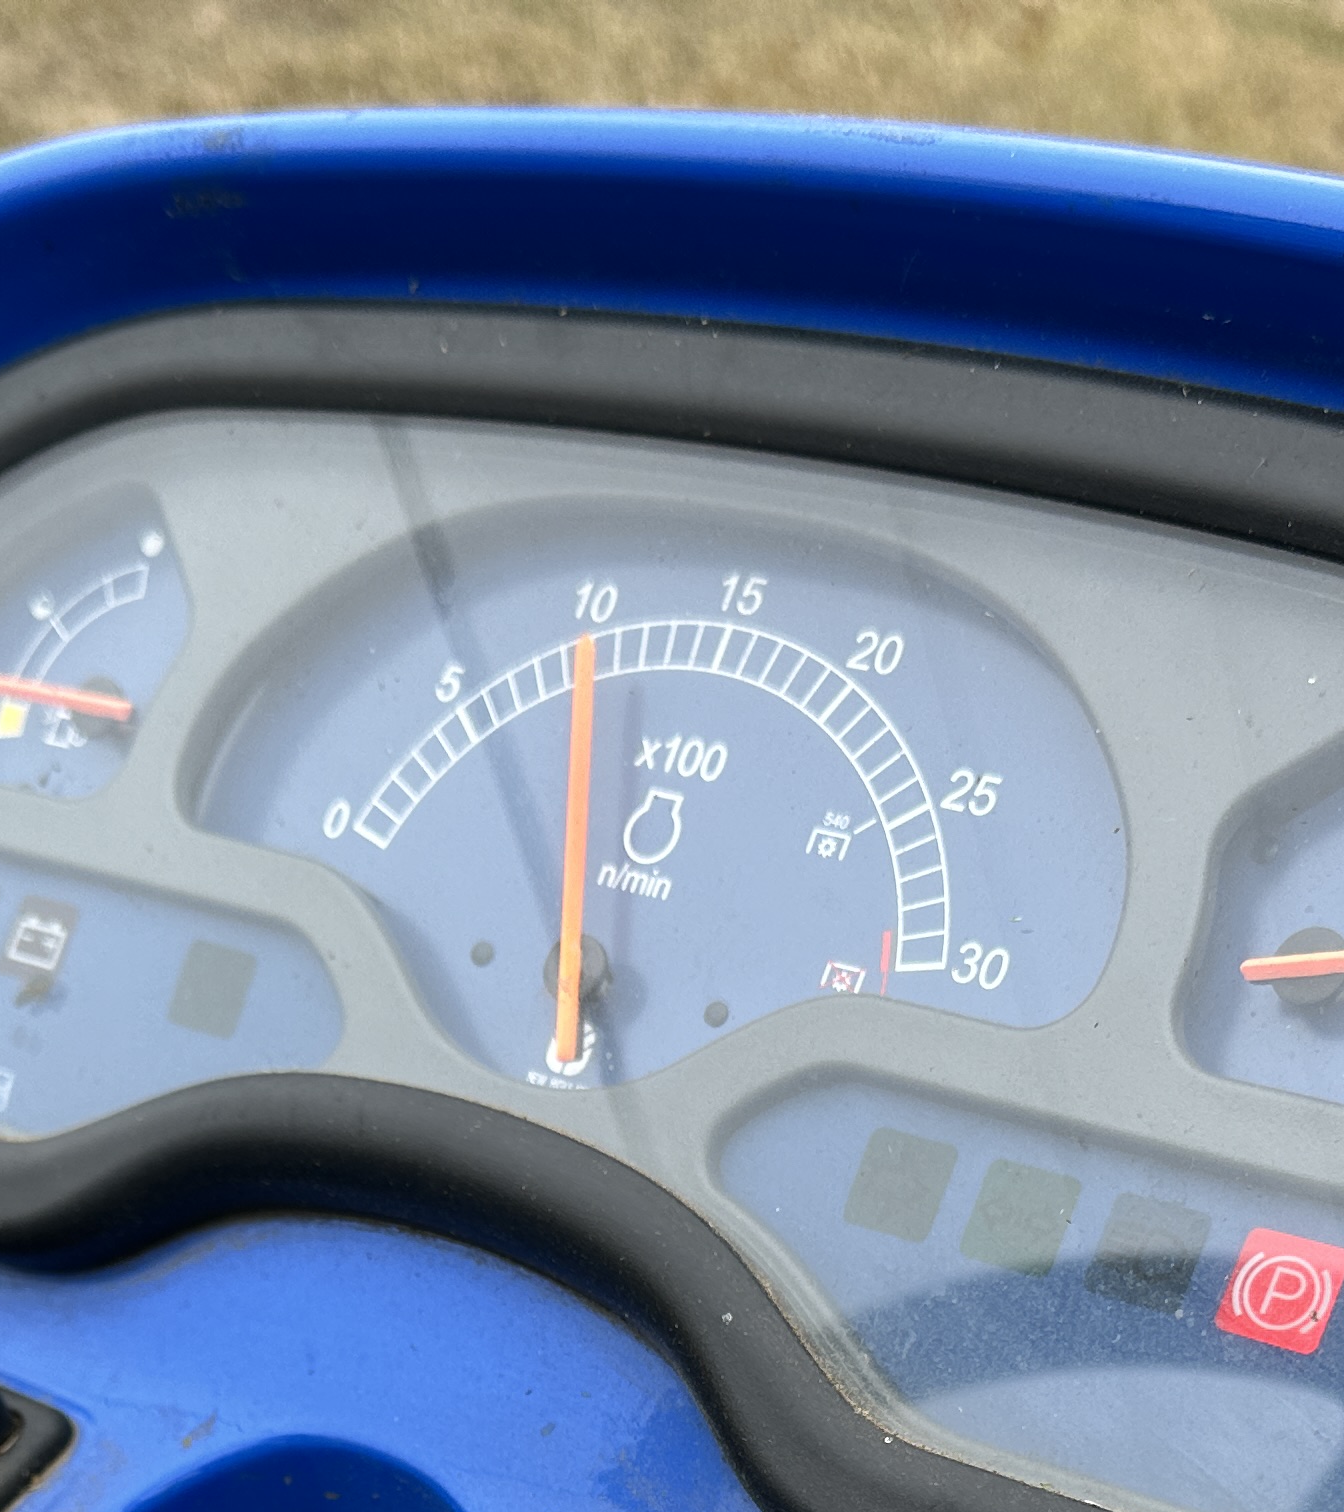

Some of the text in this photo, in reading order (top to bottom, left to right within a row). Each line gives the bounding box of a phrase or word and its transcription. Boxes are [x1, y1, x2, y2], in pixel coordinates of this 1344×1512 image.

[574, 579, 619, 624] 10
[719, 573, 769, 616] 15
[846, 630, 905, 675] 20
[435, 662, 466, 703] 5
[633, 733, 729, 782] x100
[941, 767, 1002, 817] 25
[323, 798, 350, 840] 0
[822, 811, 851, 830] 540
[597, 862, 672, 901] n/min
[951, 940, 1010, 991] 30
